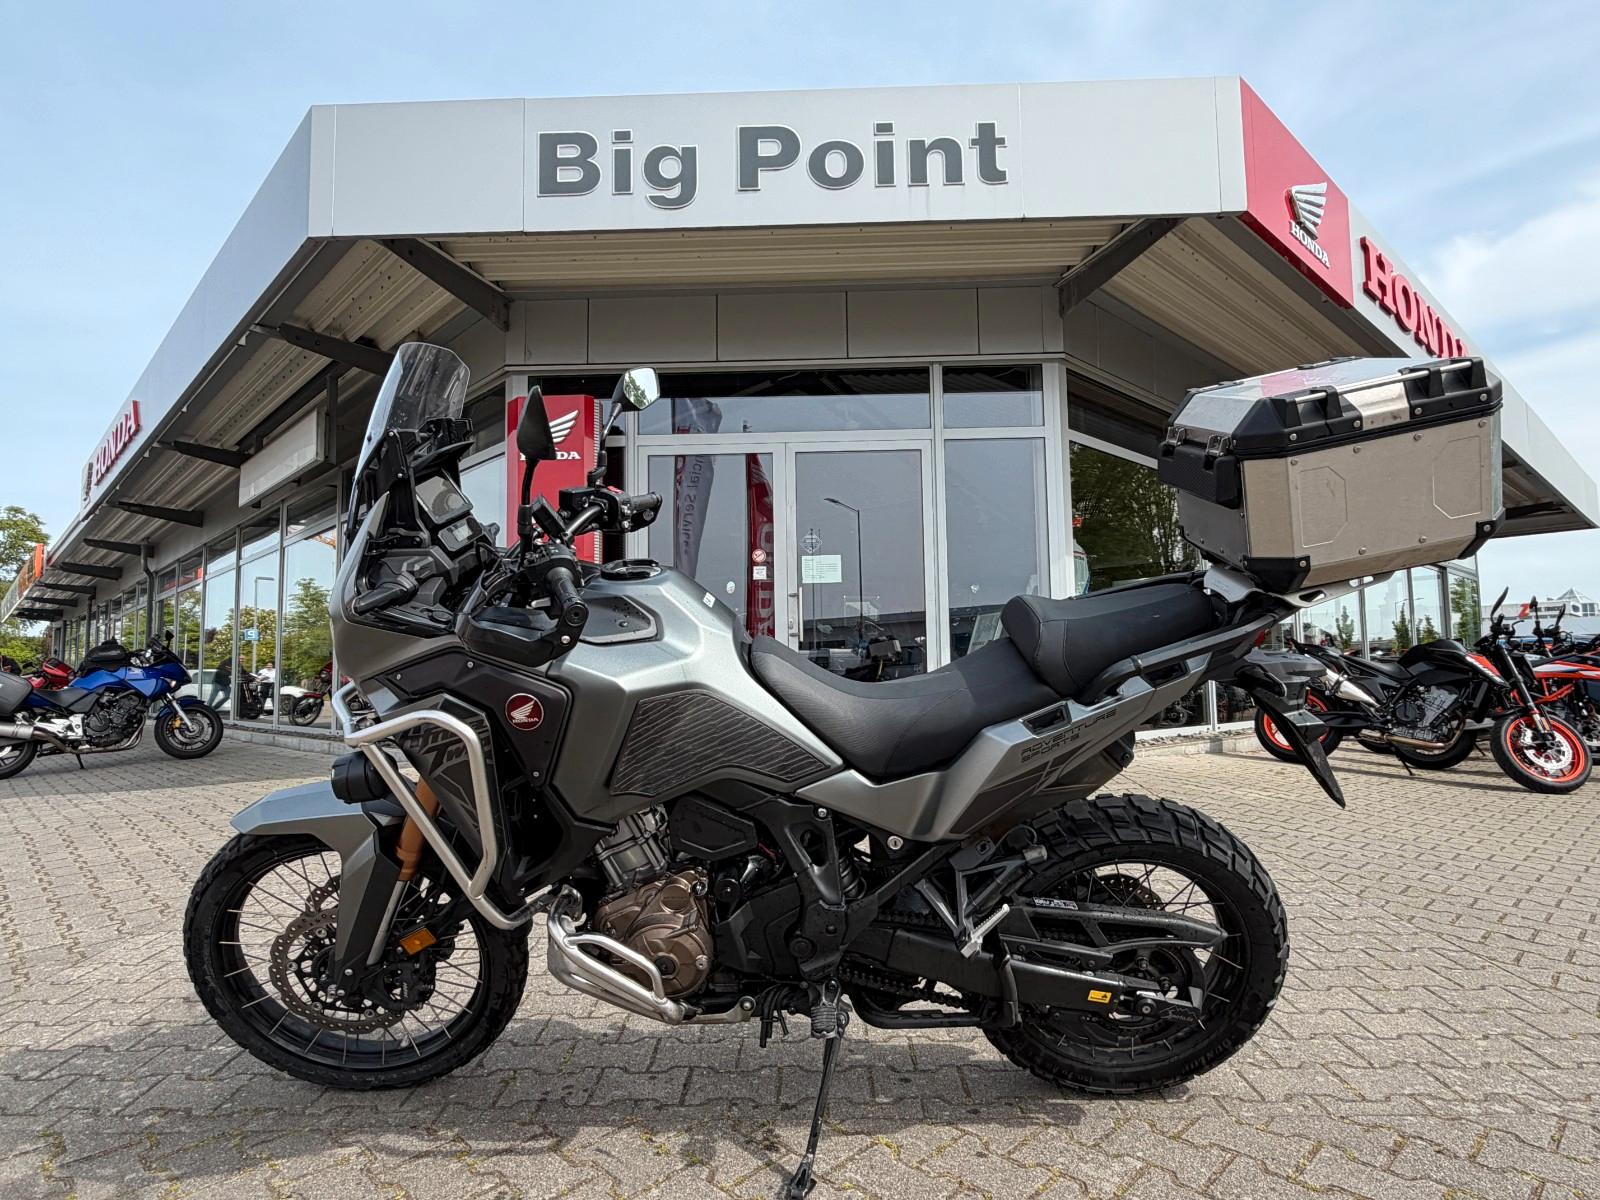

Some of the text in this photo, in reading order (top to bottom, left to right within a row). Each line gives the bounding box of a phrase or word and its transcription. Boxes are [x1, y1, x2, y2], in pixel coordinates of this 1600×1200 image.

[537, 121, 1009, 209] Big Point
[1289, 220, 1330, 268] HONDA
[93, 400, 141, 485] HONDA
